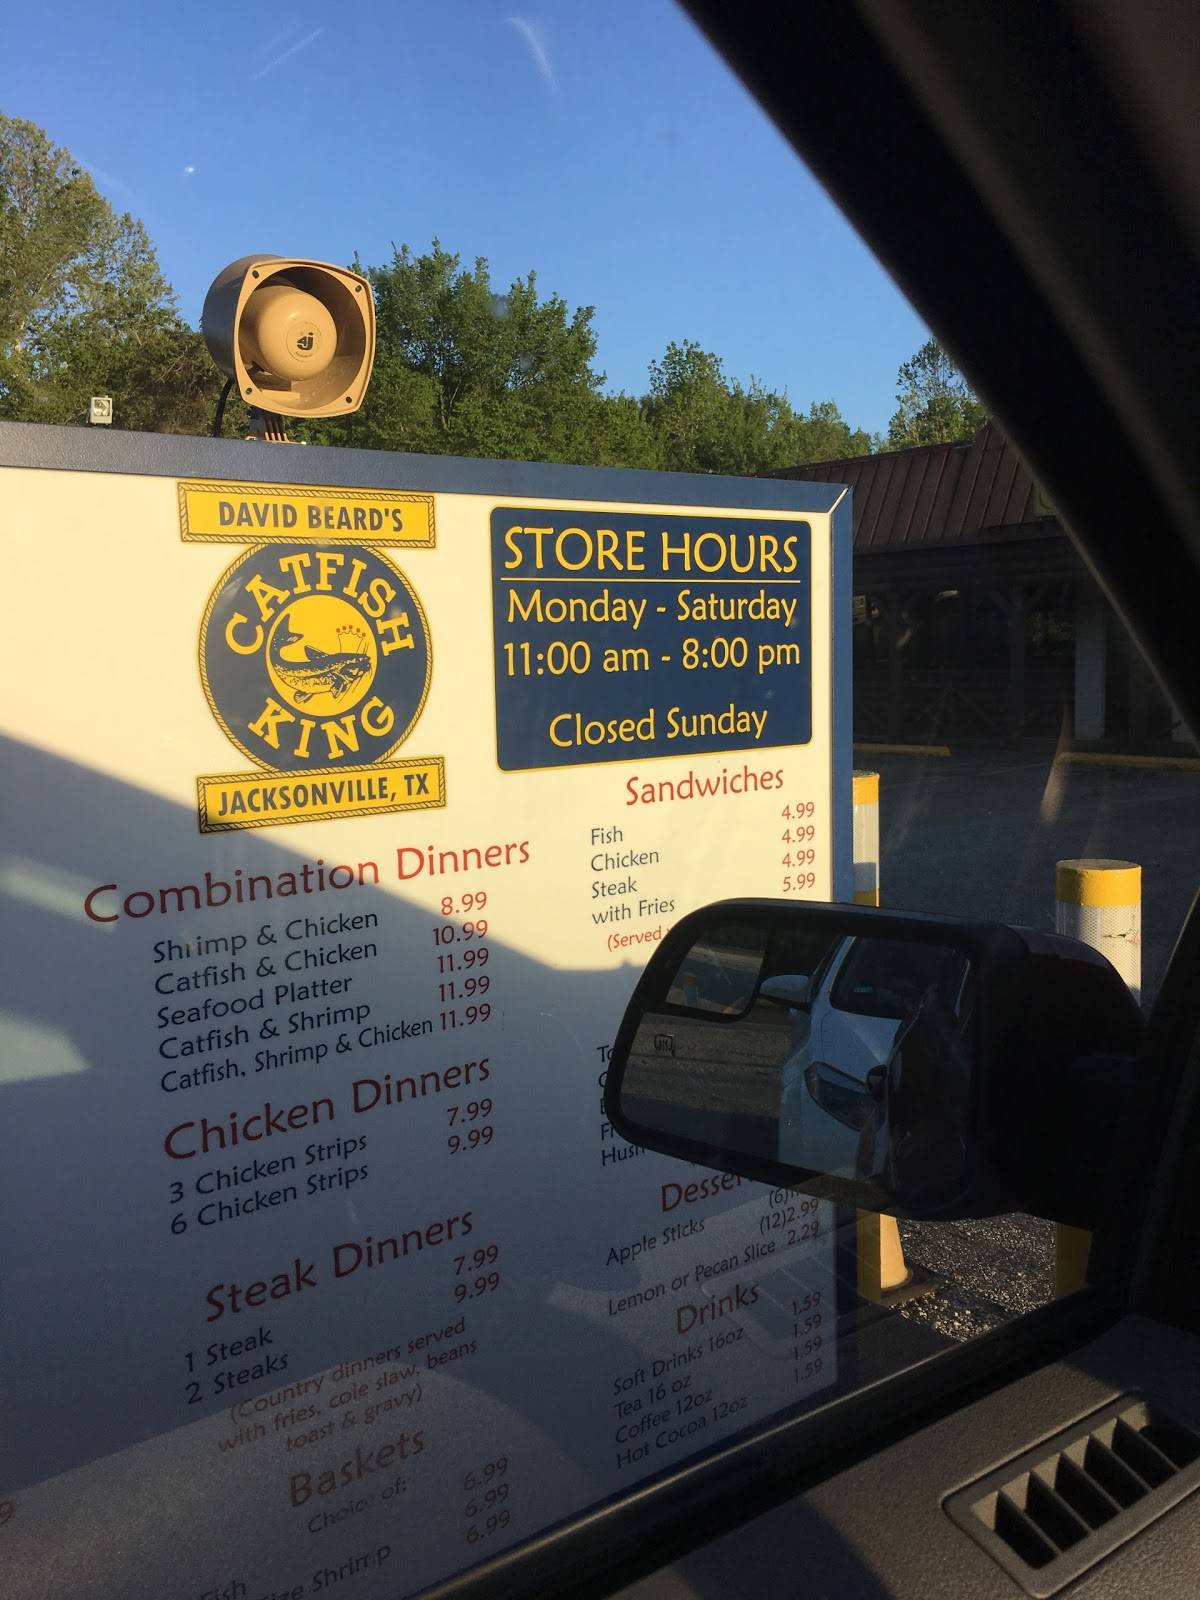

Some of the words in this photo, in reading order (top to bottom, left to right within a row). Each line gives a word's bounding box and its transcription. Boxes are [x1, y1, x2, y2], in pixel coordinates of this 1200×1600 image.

[218, 501, 297, 528] DAVID
[308, 505, 403, 532] BEARD'S
[504, 526, 645, 571] STORE
[661, 531, 798, 574] HOURS
[225, 551, 414, 656] CATFISH
[507, 588, 647, 630] Monday
[677, 589, 798, 627] Saturday
[504, 641, 591, 676] 11:00
[603, 646, 650, 673] am
[682, 637, 748, 670] 8:00
[758, 642, 801, 675] pm
[248, 696, 395, 759] KING
[549, 708, 656, 747] Closed
[667, 703, 768, 740] Sunday
[218, 777, 396, 816] JACKSONVILLE,
[404, 772, 429, 796] TX
[626, 766, 784, 806] Sandwiches
[781, 801, 815, 821] 4.99
[591, 825, 624, 845] Fish
[781, 825, 815, 845] 4.99
[590, 849, 659, 872] Chicken
[782, 849, 815, 869] 4.99
[84, 859, 380, 923] Combination
[396, 840, 531, 880] Dinners
[591, 876, 638, 899] Steak
[782, 872, 816, 893] 5.99
[440, 891, 488, 916] 8.99
[591, 903, 632, 925] with
[638, 898, 675, 917] Fries
[153, 931, 247, 964] Shrimp
[256, 925, 278, 946] &
[285, 912, 379, 941] Chicken
[433, 919, 488, 946] 10.99
[607, 925, 662, 952] (Served
[154, 962, 246, 995] Catfish
[256, 956, 277, 978] &
[285, 941, 378, 971] Chicken
[437, 947, 490, 974] 11.99
[157, 989, 265, 1029] Seafood
[274, 975, 353, 1007] Platter
[438, 975, 490, 1003] 11.99
[159, 1024, 249, 1060] Catfish
[259, 1017, 280, 1040] &
[288, 1001, 372, 1036] Shrimp
[440, 1002, 492, 1031] 11.99
[254, 1039, 329, 1074] Shrimp
[335, 1033, 353, 1054] &
[358, 1016, 433, 1049] Chicken
[164, 1097, 335, 1160] Chicken
[352, 1057, 490, 1114] Dinners
[447, 1098, 493, 1127] 7.99
[447, 1126, 494, 1154] 9.99
[169, 1181, 184, 1204] 3
[195, 1155, 296, 1195] Chicken
[304, 1135, 368, 1165] Strips
[170, 1212, 188, 1235] 6
[197, 1184, 298, 1227] Chicken
[306, 1164, 369, 1196] Strips
[606, 1235, 657, 1266] Apple
[663, 1218, 705, 1246] Sticks
[787, 1220, 819, 1247] 2.29
[206, 1257, 318, 1323] Steak
[332, 1211, 473, 1279] Dinners
[453, 1244, 499, 1276] 7.99
[609, 1283, 666, 1317] Lemon
[671, 1274, 689, 1291] or
[695, 1255, 738, 1282] Pecan
[744, 1239, 776, 1264] Slice
[454, 1271, 500, 1304] 9.99
[792, 1291, 821, 1316] 1.59
[676, 1284, 760, 1335] Drinks
[793, 1314, 822, 1338] 1.59
[184, 1352, 195, 1373] 1
[206, 1326, 273, 1366] Steak
[614, 1368, 646, 1396] Soft
[652, 1345, 702, 1378] Drinks
[709, 1327, 744, 1352] 16oz
[794, 1336, 822, 1361] 1.59
[185, 1382, 203, 1405] 2
[213, 1353, 289, 1396] Steaks
[230, 1374, 325, 1425] (Country
[331, 1346, 401, 1383] dinners
[407, 1316, 466, 1353] served
[794, 1358, 823, 1384] 1.59
[217, 1422, 267, 1453] with
[329, 1382, 369, 1409] cole
[426, 1339, 478, 1370] beans
[614, 1399, 642, 1419] Tea
[650, 1385, 666, 1404] 16
[672, 1375, 692, 1394] oz
[615, 1408, 671, 1444] Coffee
[676, 1389, 713, 1416] 12oz
[286, 1421, 336, 1452] toast
[341, 1411, 358, 1429] &
[364, 1383, 424, 1425] gravy)
[616, 1444, 650, 1470] Hot
[656, 1416, 706, 1449] Cocoa
[713, 1396, 750, 1422] 12oz
[287, 1429, 425, 1508] Baskets
[463, 1457, 508, 1491] 6.99
[464, 1484, 510, 1518] 6.99
[465, 1510, 511, 1544] 6.99
[311, 1545, 391, 1593] Shrimp
